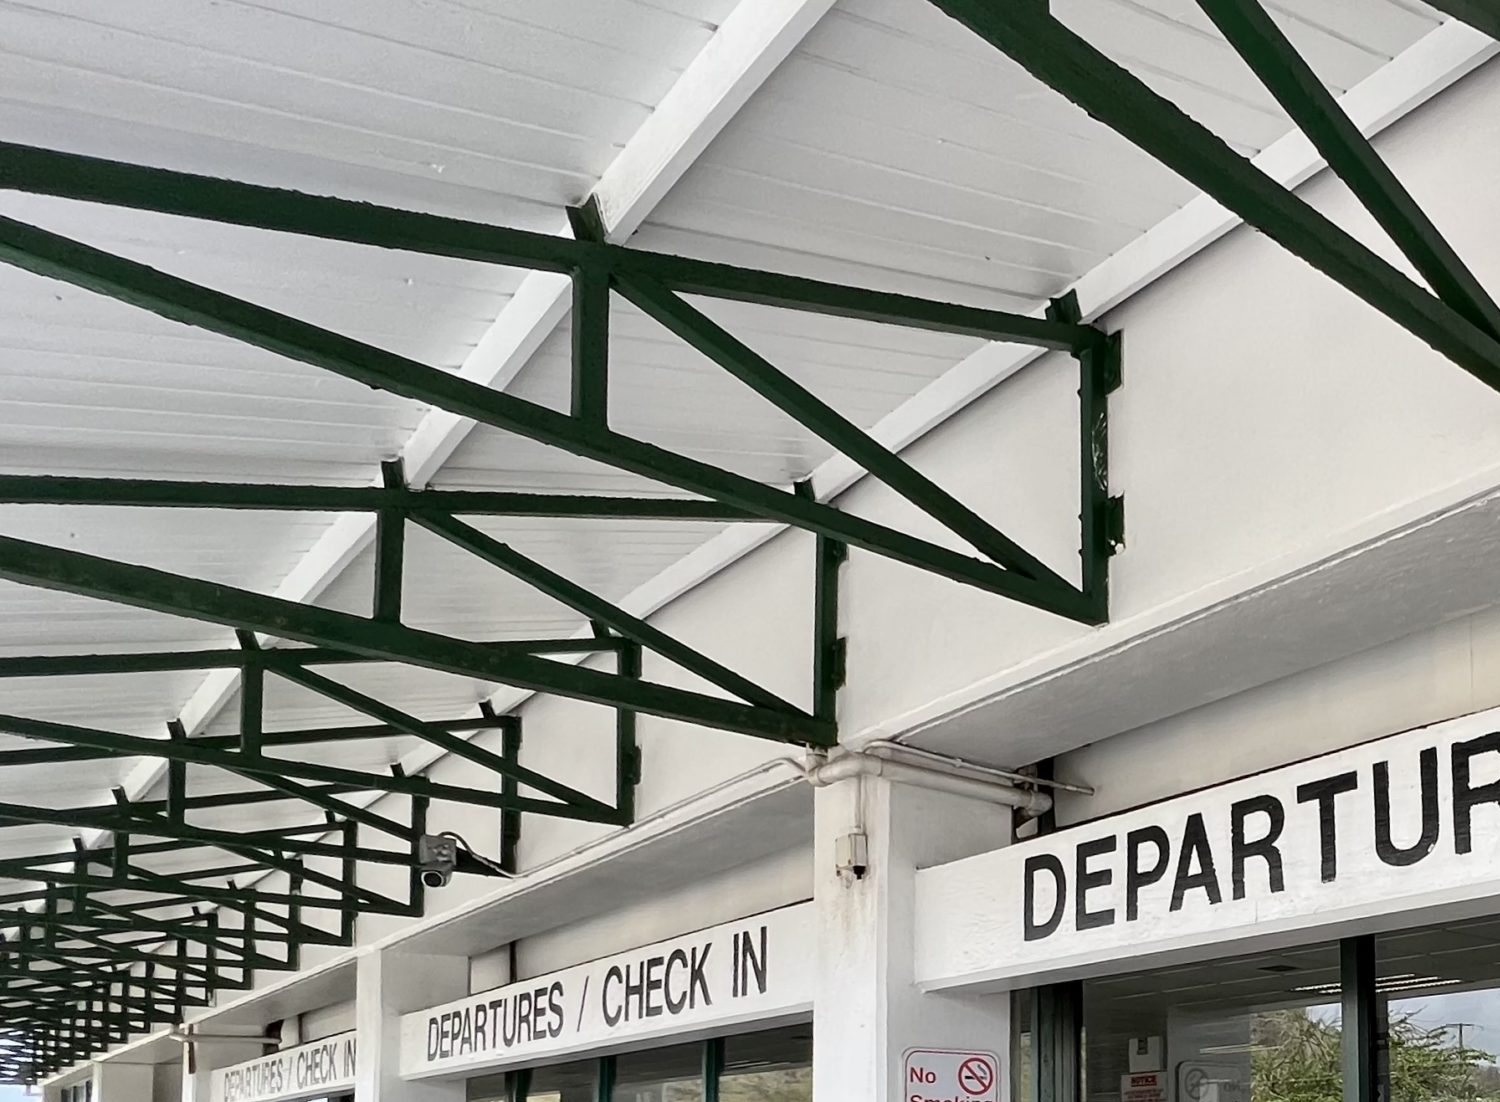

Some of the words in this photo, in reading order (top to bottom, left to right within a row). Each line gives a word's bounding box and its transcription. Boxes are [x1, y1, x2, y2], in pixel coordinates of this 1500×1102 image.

[427, 981, 563, 1061] DEPARTURES
[577, 976, 590, 1032] /
[602, 943, 712, 1027] CHECK
[733, 926, 767, 998] IN
[224, 1058, 283, 1102] DEPARTURES
[297, 1042, 337, 1089] CHECK
[344, 1038, 357, 1077] IN
[910, 1067, 936, 1083] No
